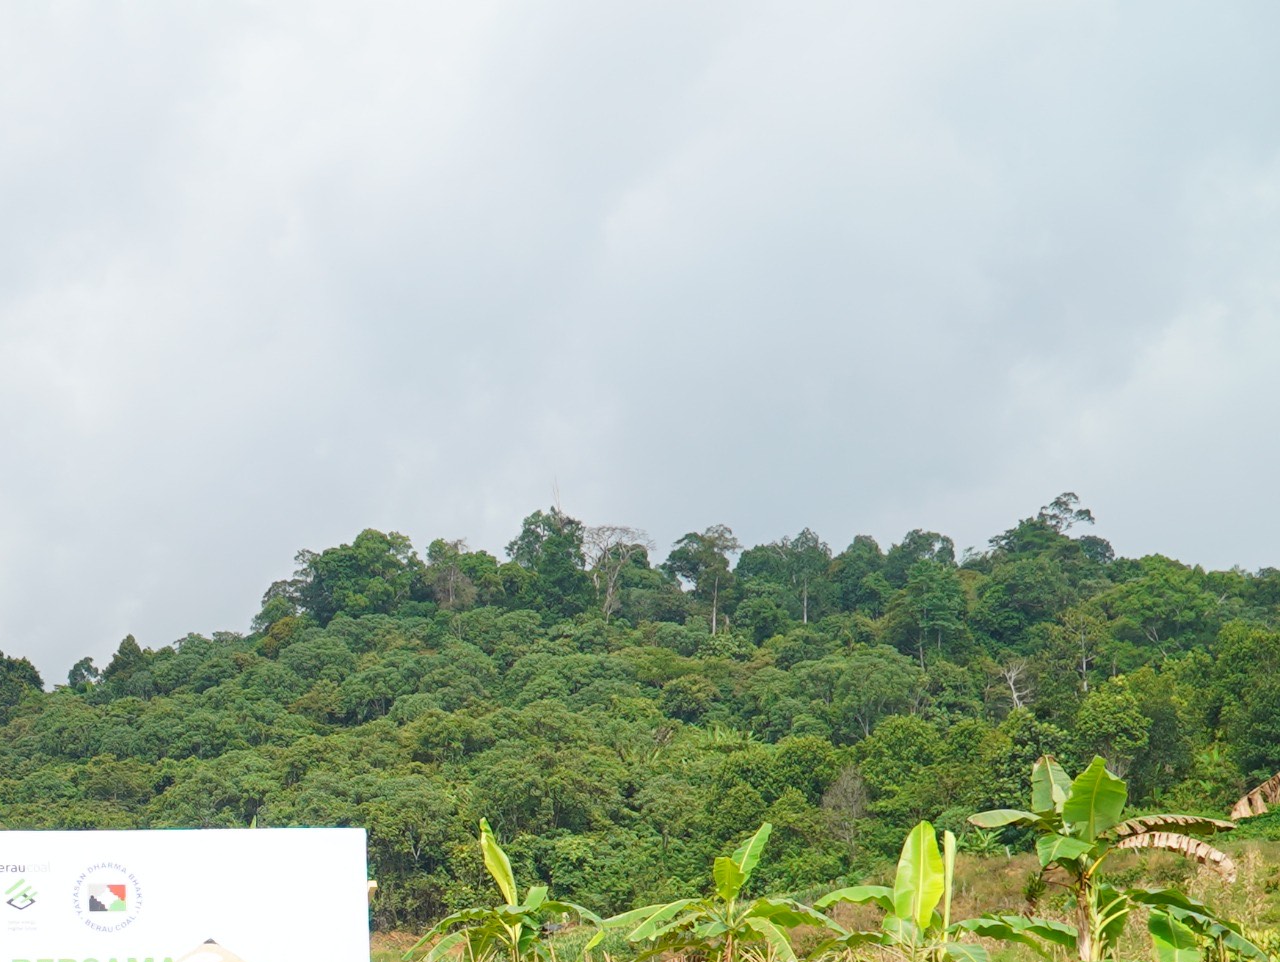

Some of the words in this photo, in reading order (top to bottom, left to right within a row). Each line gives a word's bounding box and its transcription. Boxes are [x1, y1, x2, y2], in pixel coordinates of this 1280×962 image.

[87, 862, 127, 874] DHARMA
[128, 873, 142, 910] BHAKTI
[84, 919, 114, 933] BERAU
[115, 916, 137, 931] COAL
